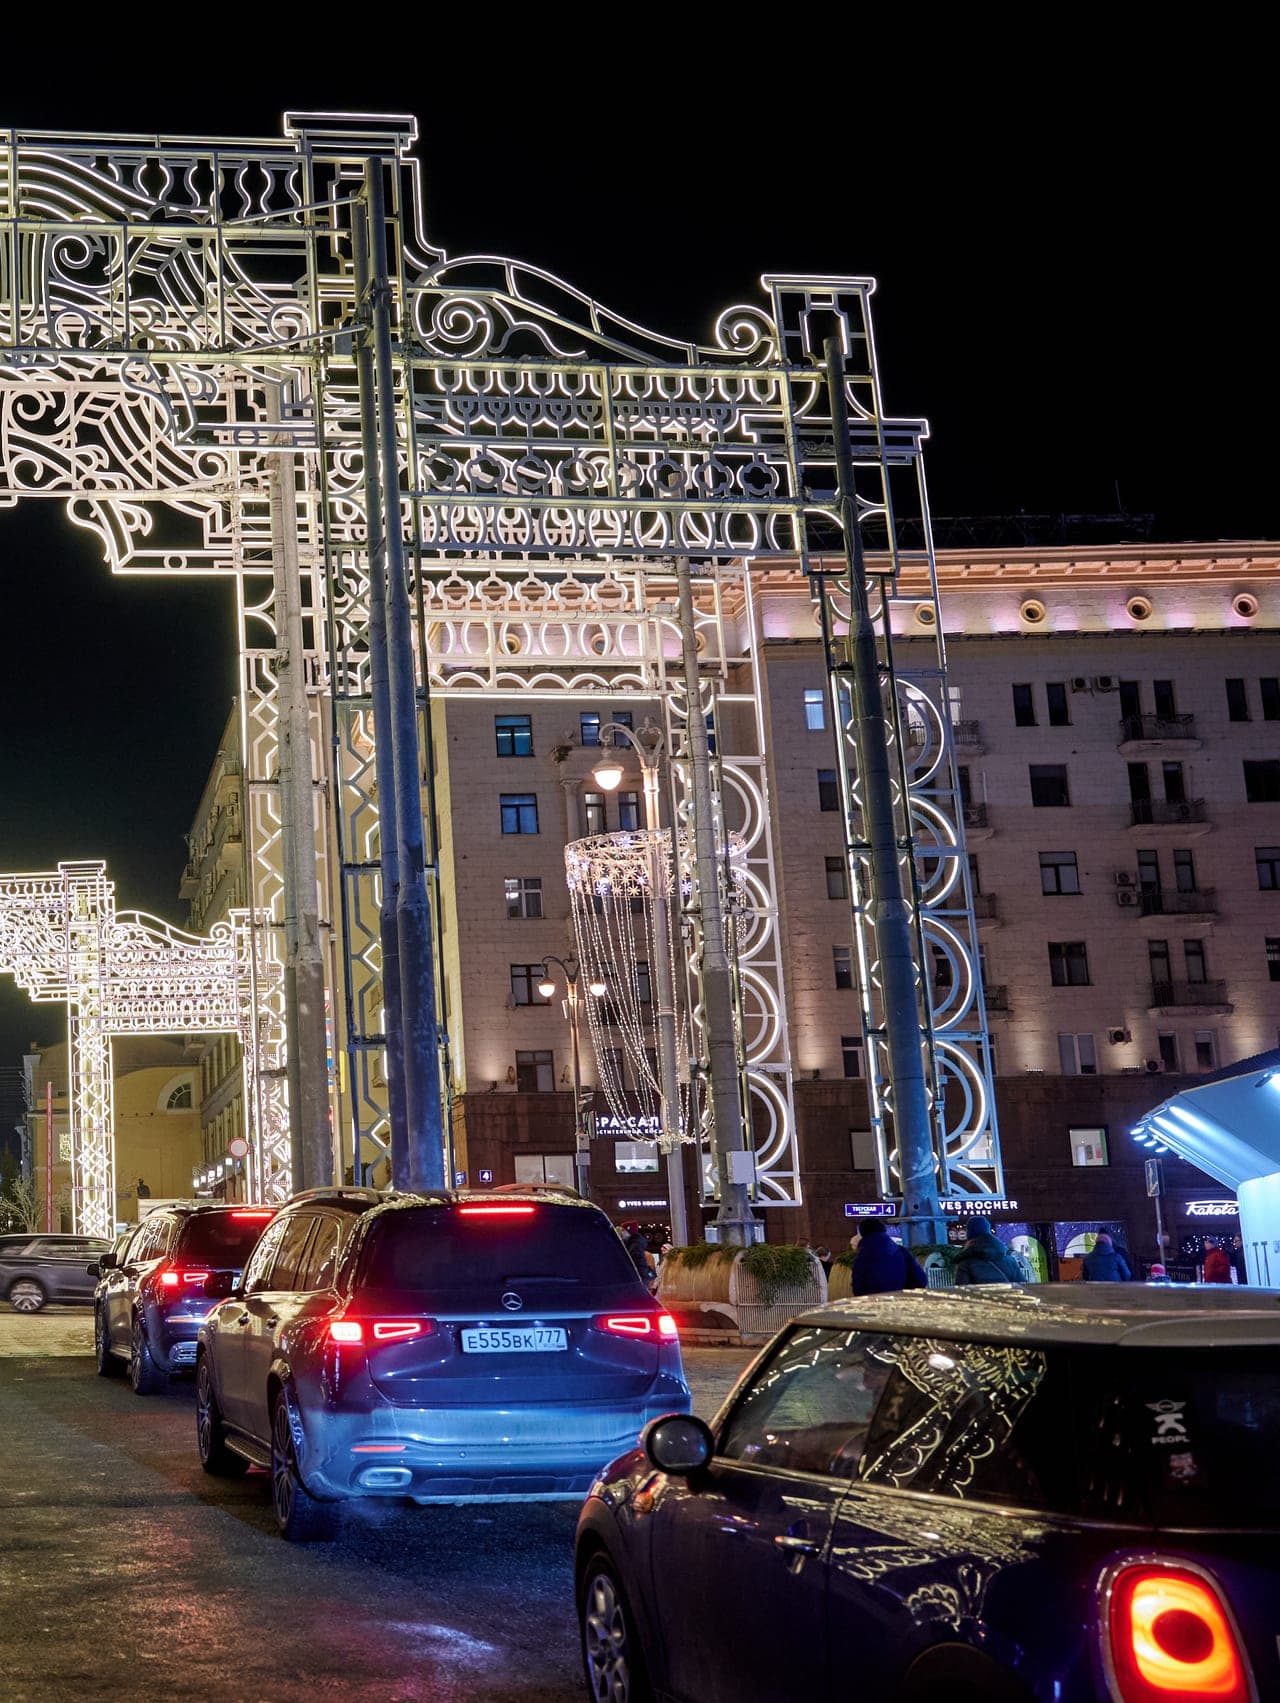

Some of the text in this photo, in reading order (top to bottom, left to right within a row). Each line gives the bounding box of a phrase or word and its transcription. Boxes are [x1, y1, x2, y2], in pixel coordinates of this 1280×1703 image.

[482, 1171, 489, 1180] 4
[885, 1206, 892, 1214] 4
[939, 1201, 1018, 1210] VES ROCHER
[467, 1330, 561, 1349] Е555ВК 777
